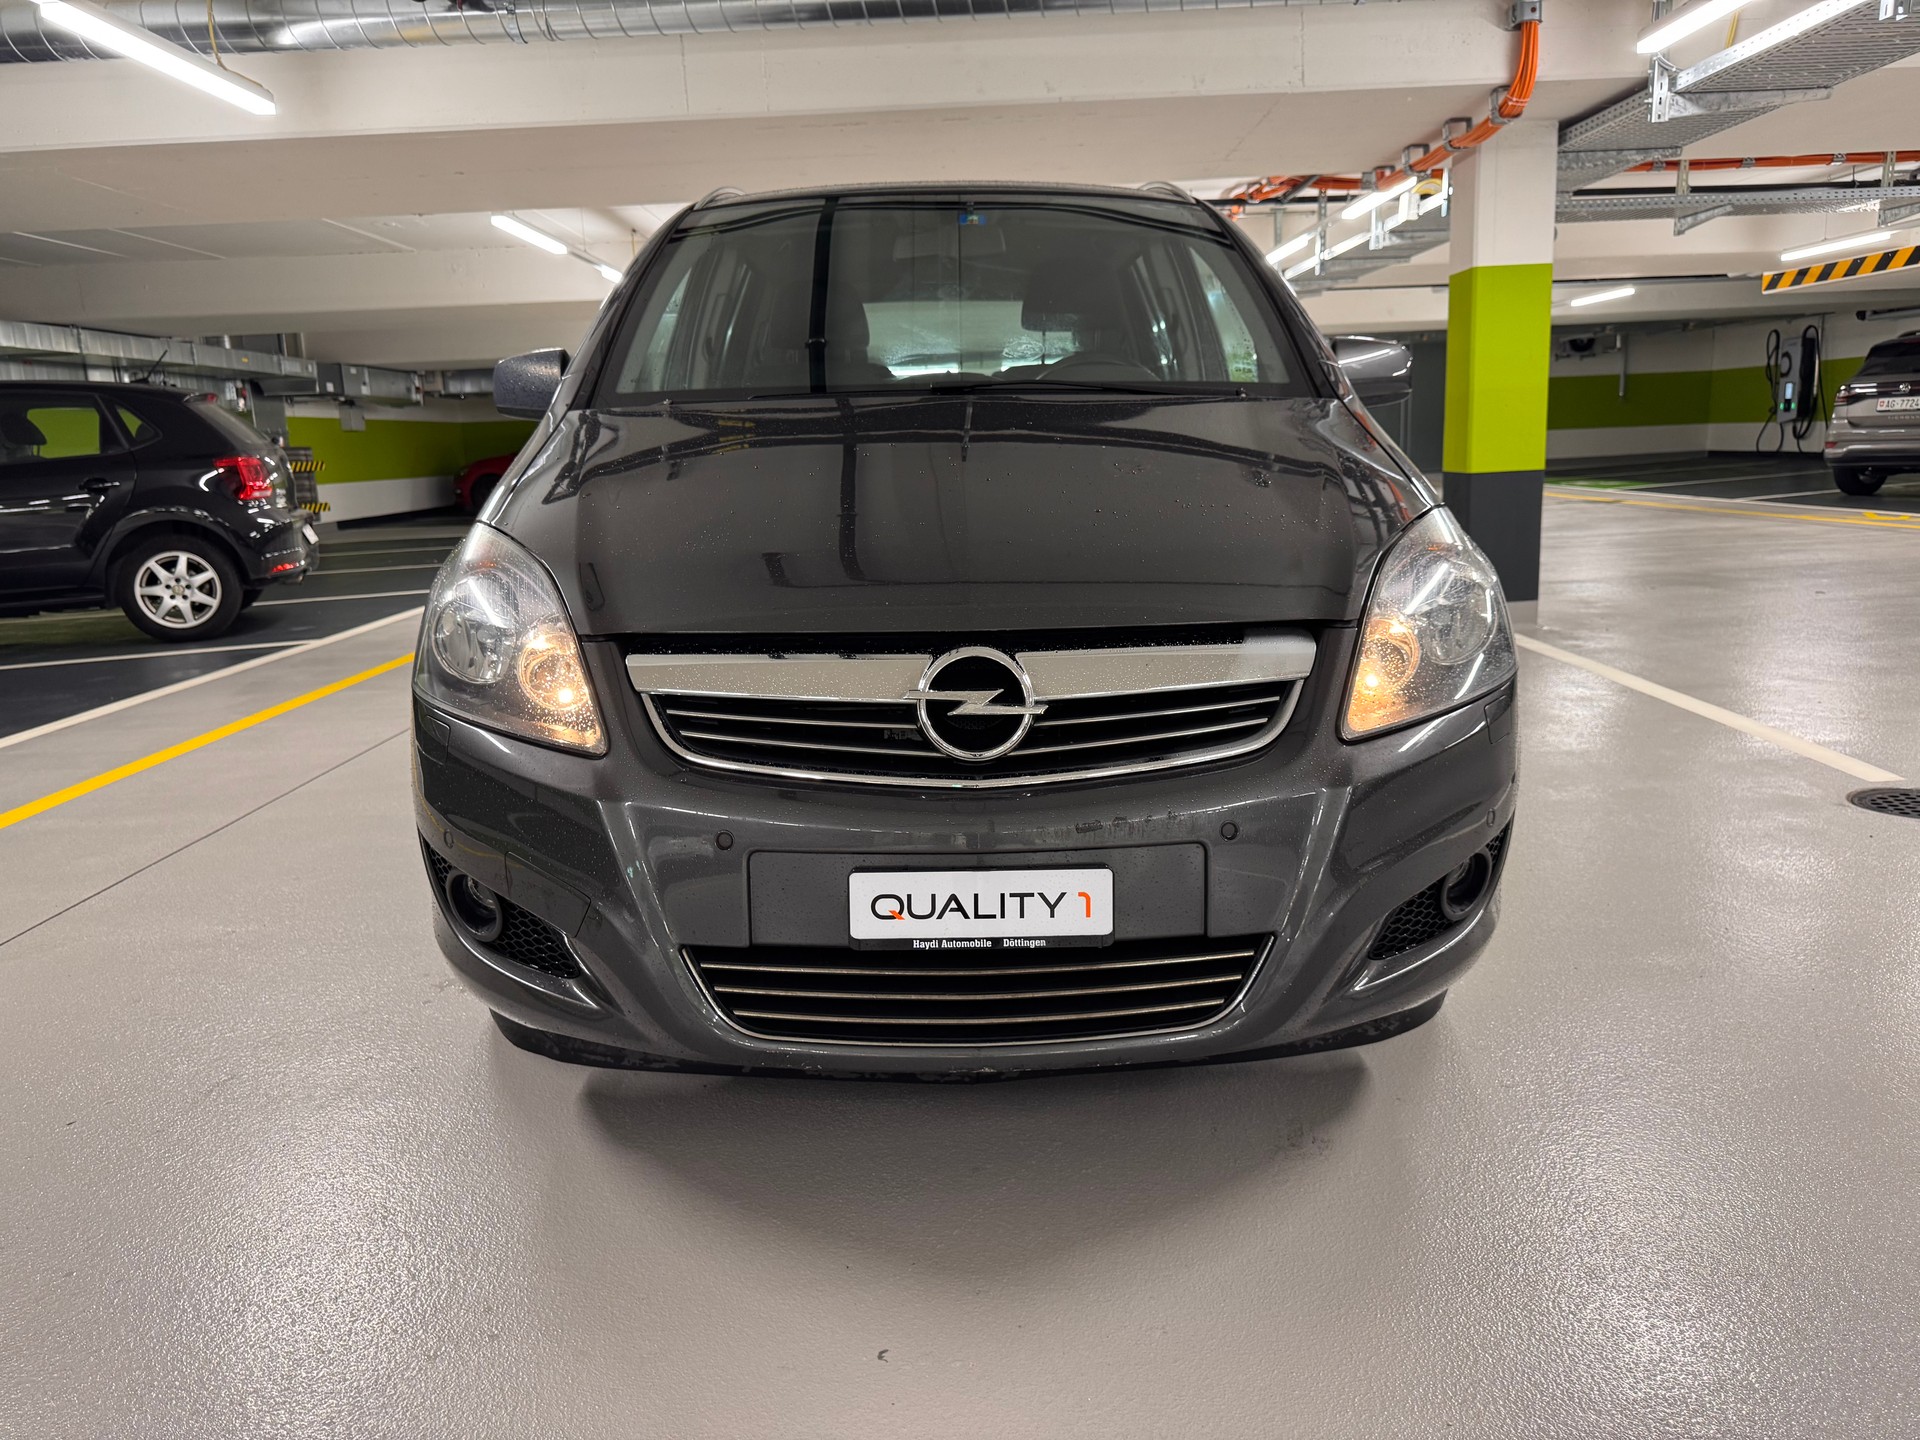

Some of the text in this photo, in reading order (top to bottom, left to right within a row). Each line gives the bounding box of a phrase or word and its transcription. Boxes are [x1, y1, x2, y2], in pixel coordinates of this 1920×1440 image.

[871, 891, 1091, 920] QUALITY 1
[913, 938, 1046, 950] Haydi Automobile Döttingen
